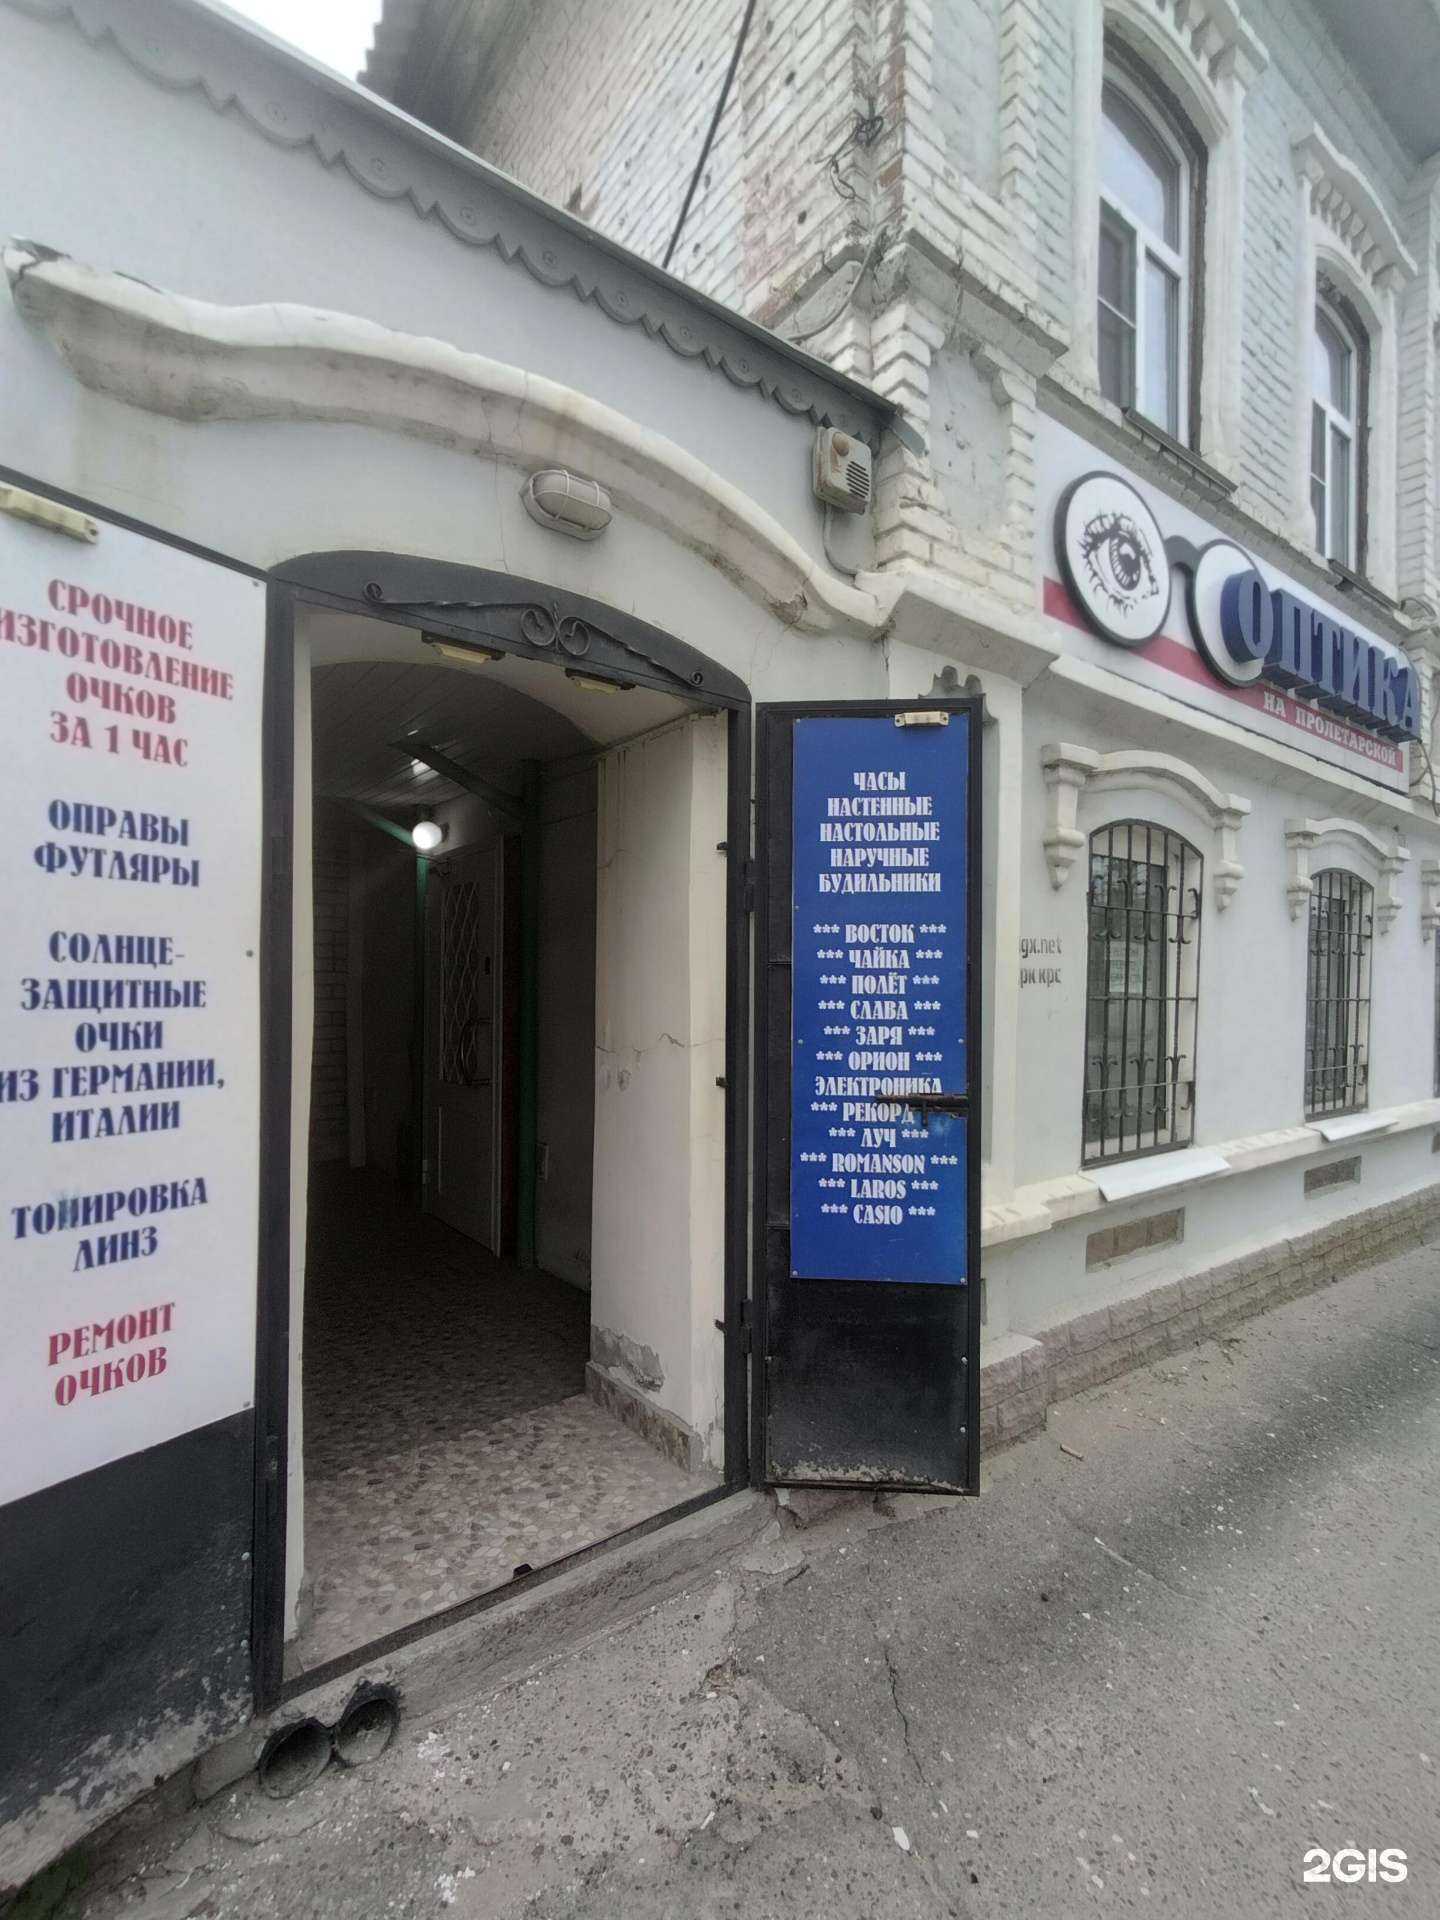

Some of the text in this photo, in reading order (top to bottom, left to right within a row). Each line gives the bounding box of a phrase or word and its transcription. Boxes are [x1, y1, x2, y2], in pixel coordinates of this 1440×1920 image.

[48, 578, 193, 651] СРОЧНОЕ
[0, 607, 234, 701] ИЗГОТОВЛЕНИЕ
[1220, 569, 1422, 741] ОПТИКА
[65, 672, 176, 725] ОЧКОВ
[50, 710, 188, 767] ЗА 1 ЧАС
[1264, 691, 1397, 767] НА ПРОЛЕТАРСКОЙ
[853, 771, 906, 791] ЧАСЫ
[48, 799, 190, 848] ОПРАВЫ
[827, 796, 932, 817] НАСТЕННЫЕ
[820, 822, 940, 842] НАСТОЛЬНЫЕ
[33, 841, 200, 888] ФУТЛЯРЫ
[830, 848, 929, 867] НАРУЧНЫЕ
[819, 873, 941, 894] БУДИЛЬНИКИ
[48, 930, 186, 968] СОЛНЦЕ-
[845, 924, 915, 944] ВОСТОК
[849, 946, 910, 969] ЧАЙКА
[20, 977, 207, 1014] ЗАЩИТНЫЕ
[850, 1000, 908, 1020] СЛАВА
[75, 1020, 163, 1054] ОЧКИ
[855, 1026, 903, 1046] ЗАРЯ
[848, 1051, 910, 1071] ОРИОН
[0, 1058, 226, 1103] ИЗ ГЕРМАНИИ,
[815, 1076, 943, 1096] ЭЛЕКТРОНИКА
[52, 1100, 180, 1143] ИТАЛИИ
[843, 1102, 914, 1124] РЕКОРД
[860, 1128, 897, 1148] ЛУЧ
[832, 1153, 925, 1174] ROMANSON
[850, 1179, 907, 1199] LAROS
[12, 1176, 208, 1240] ТОНИРОВКА
[853, 1204, 903, 1225] CASIO
[73, 1226, 158, 1272] ЛИНЗ
[48, 1302, 175, 1366] РЕМОНТ
[55, 1346, 167, 1407] ОЧКОВ
